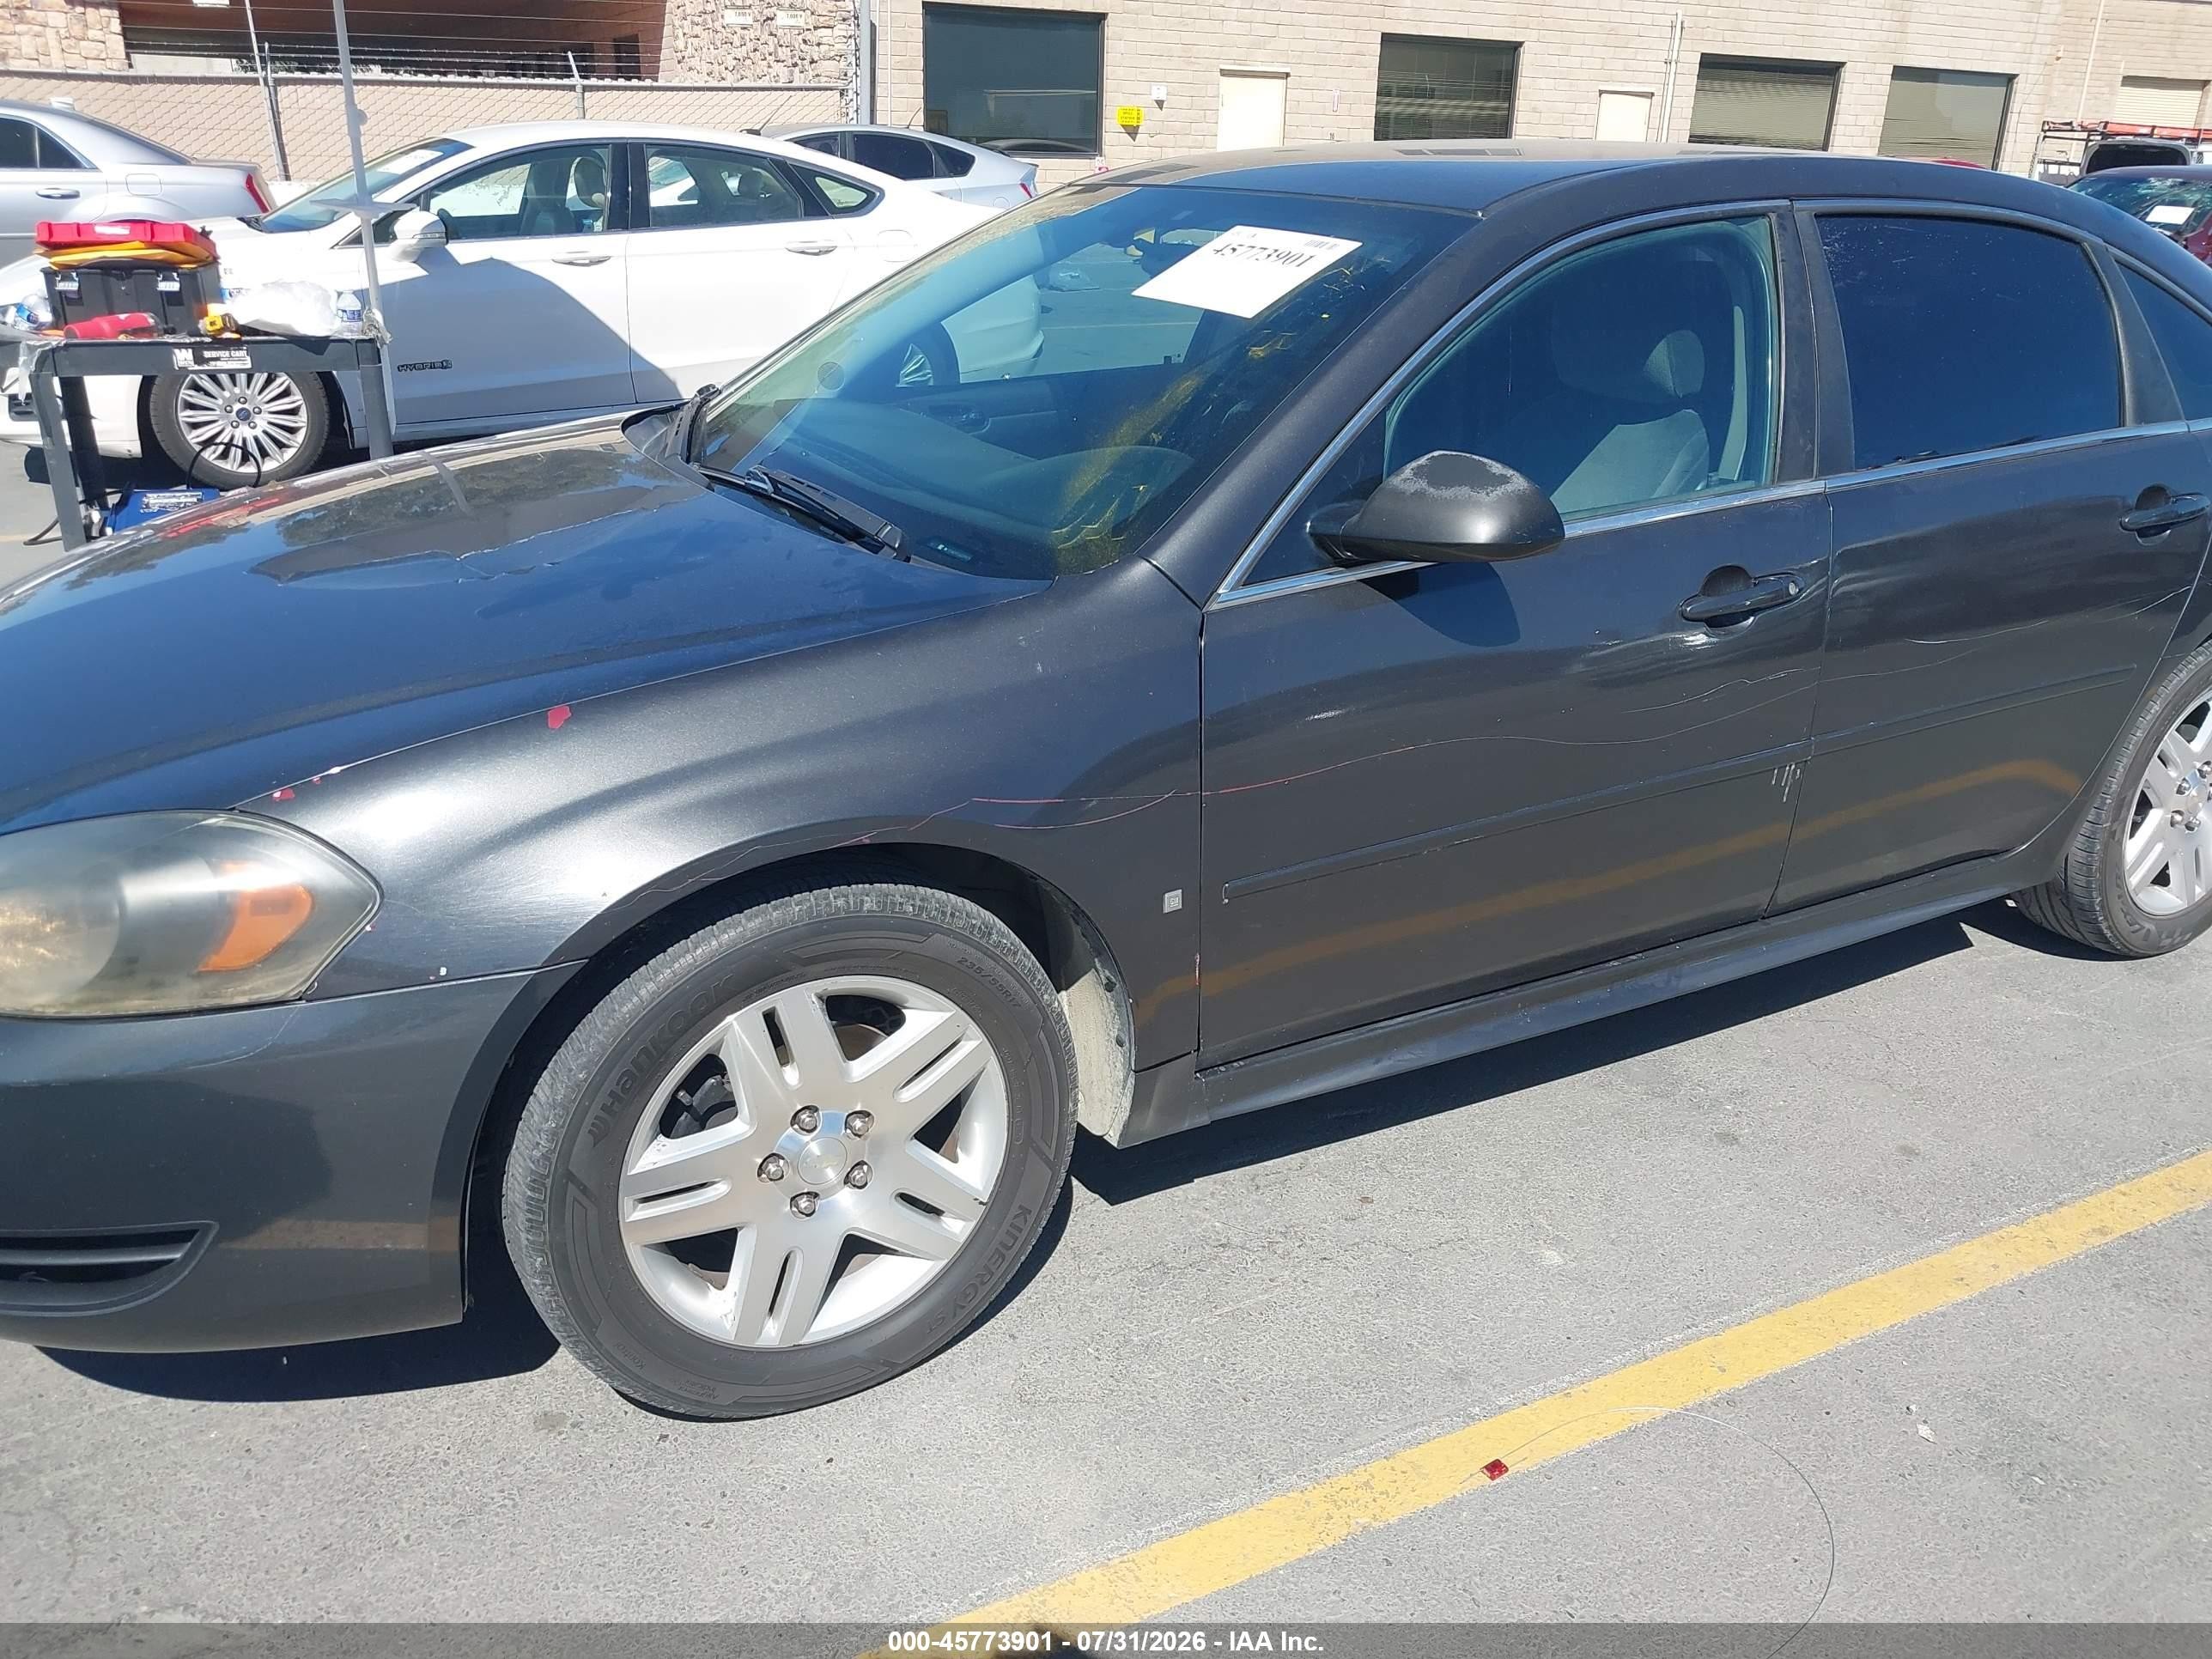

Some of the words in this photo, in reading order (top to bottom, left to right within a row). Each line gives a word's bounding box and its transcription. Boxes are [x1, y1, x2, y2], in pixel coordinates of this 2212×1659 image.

[1212, 243, 1317, 267] 45773901
[397, 362, 443, 372] HYBRID
[957, 957, 1022, 1007] 235/55R17
[952, 1205, 1032, 1317] KINERGY
